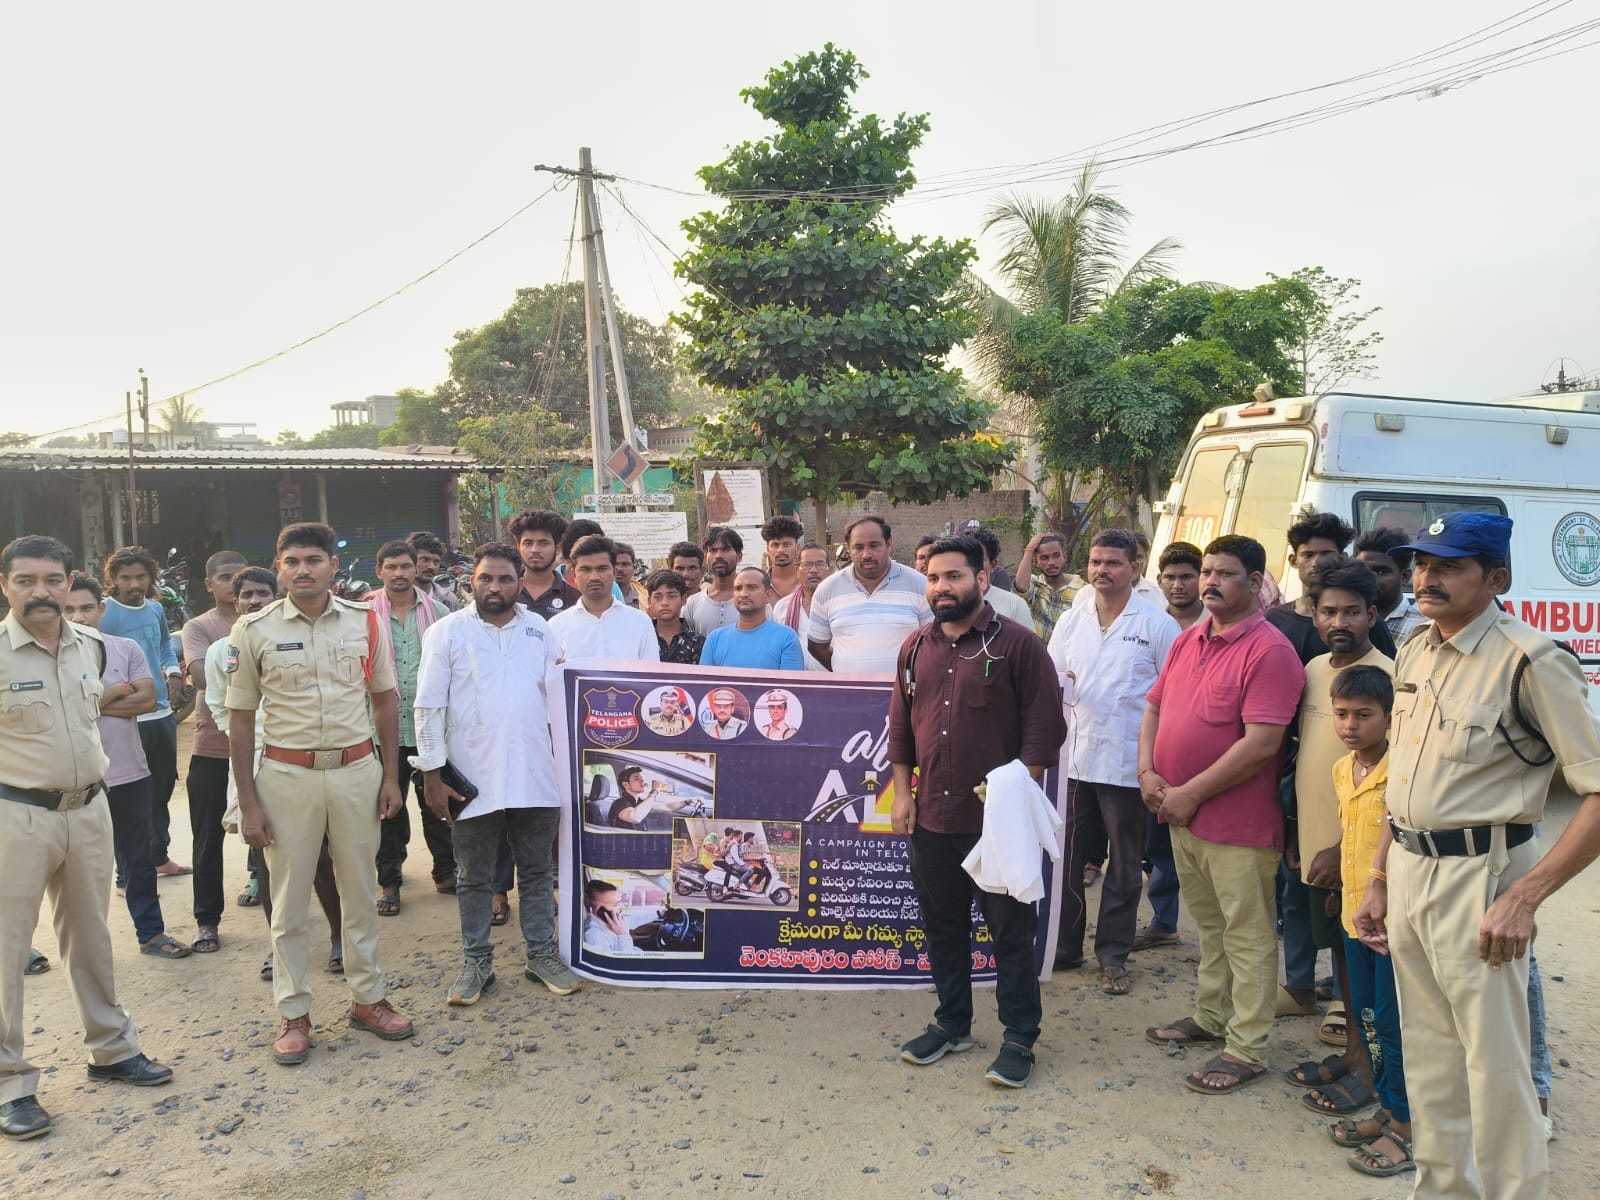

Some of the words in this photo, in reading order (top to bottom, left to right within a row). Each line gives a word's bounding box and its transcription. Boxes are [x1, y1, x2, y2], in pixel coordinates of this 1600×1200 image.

[1184, 516, 1214, 550] 108
[1503, 600, 1600, 633] MBU
[591, 709, 633, 717] TELANGANA
[588, 716, 635, 728] POLICE
[805, 838, 812, 846] A
[818, 838, 885, 849] CAMPAIGN
[891, 841, 907, 849] FO
[855, 849, 869, 857] IN
[876, 849, 909, 859] TELA
[822, 858, 840, 870] సెల్
[821, 876, 855, 892] మద్యం
[856, 907, 899, 919] మరియు
[778, 917, 840, 946] క్షేమంగా
[843, 921, 863, 941] మీ
[866, 923, 903, 949] గమ్య
[739, 945, 849, 973] వెంకటాపురం
[851, 947, 902, 970] పోలీస్
